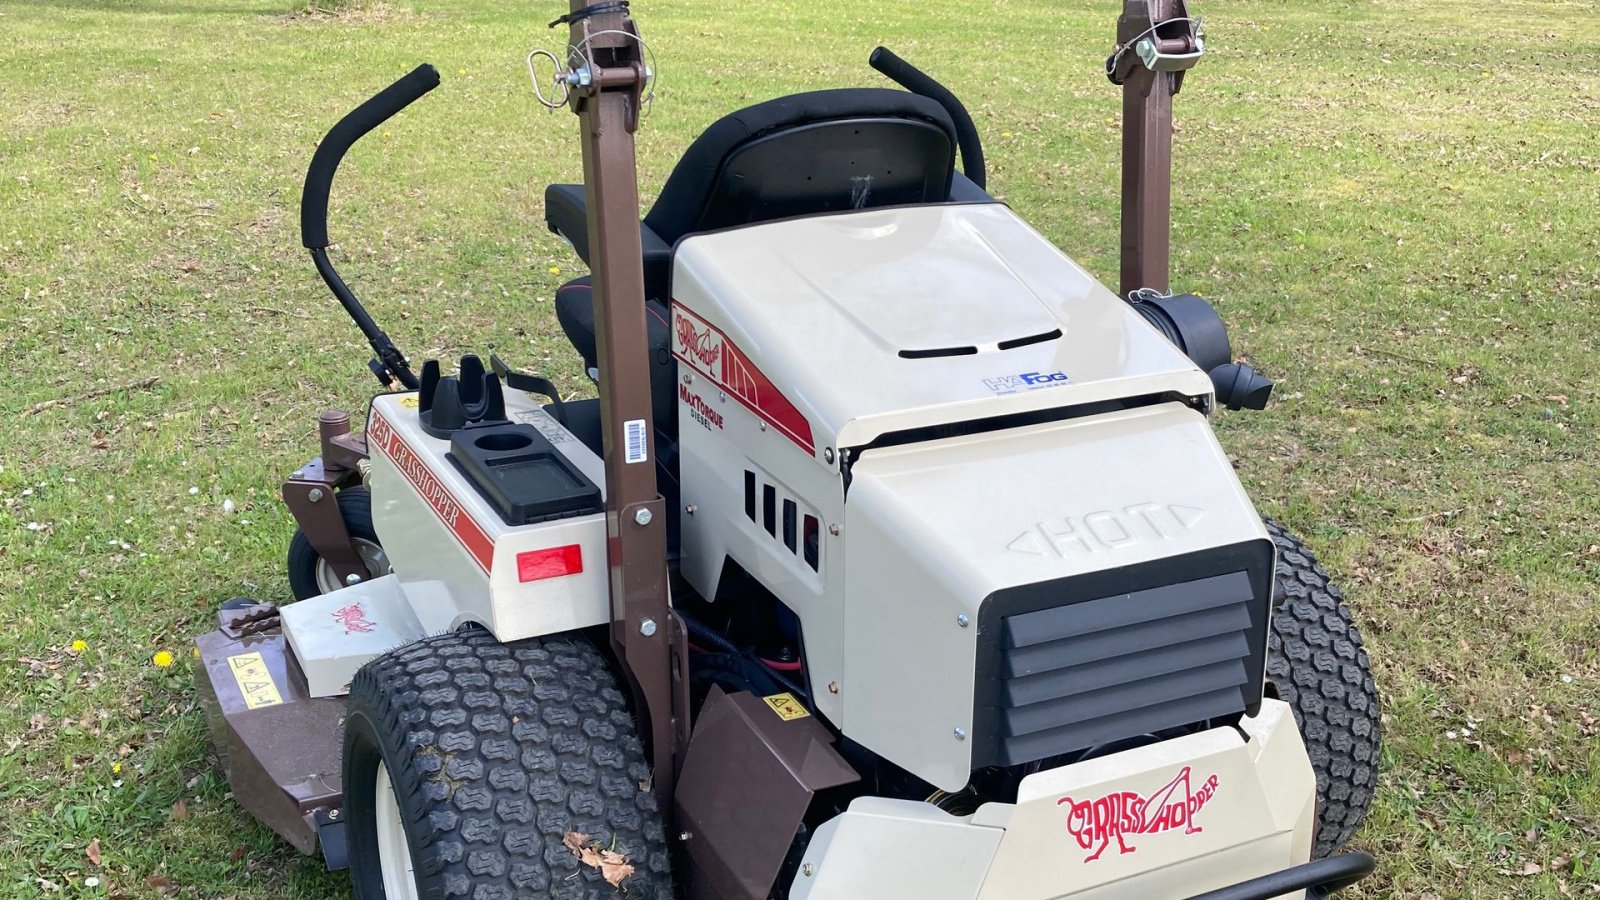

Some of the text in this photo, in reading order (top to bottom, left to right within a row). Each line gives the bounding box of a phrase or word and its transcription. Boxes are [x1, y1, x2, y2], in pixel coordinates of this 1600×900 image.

[690, 408, 712, 431] DIESEL
[393, 441, 460, 528] GRASSHOPPER
[1037, 501, 1162, 558] HOT
[1058, 766, 1220, 863] GRASSHOPPER
